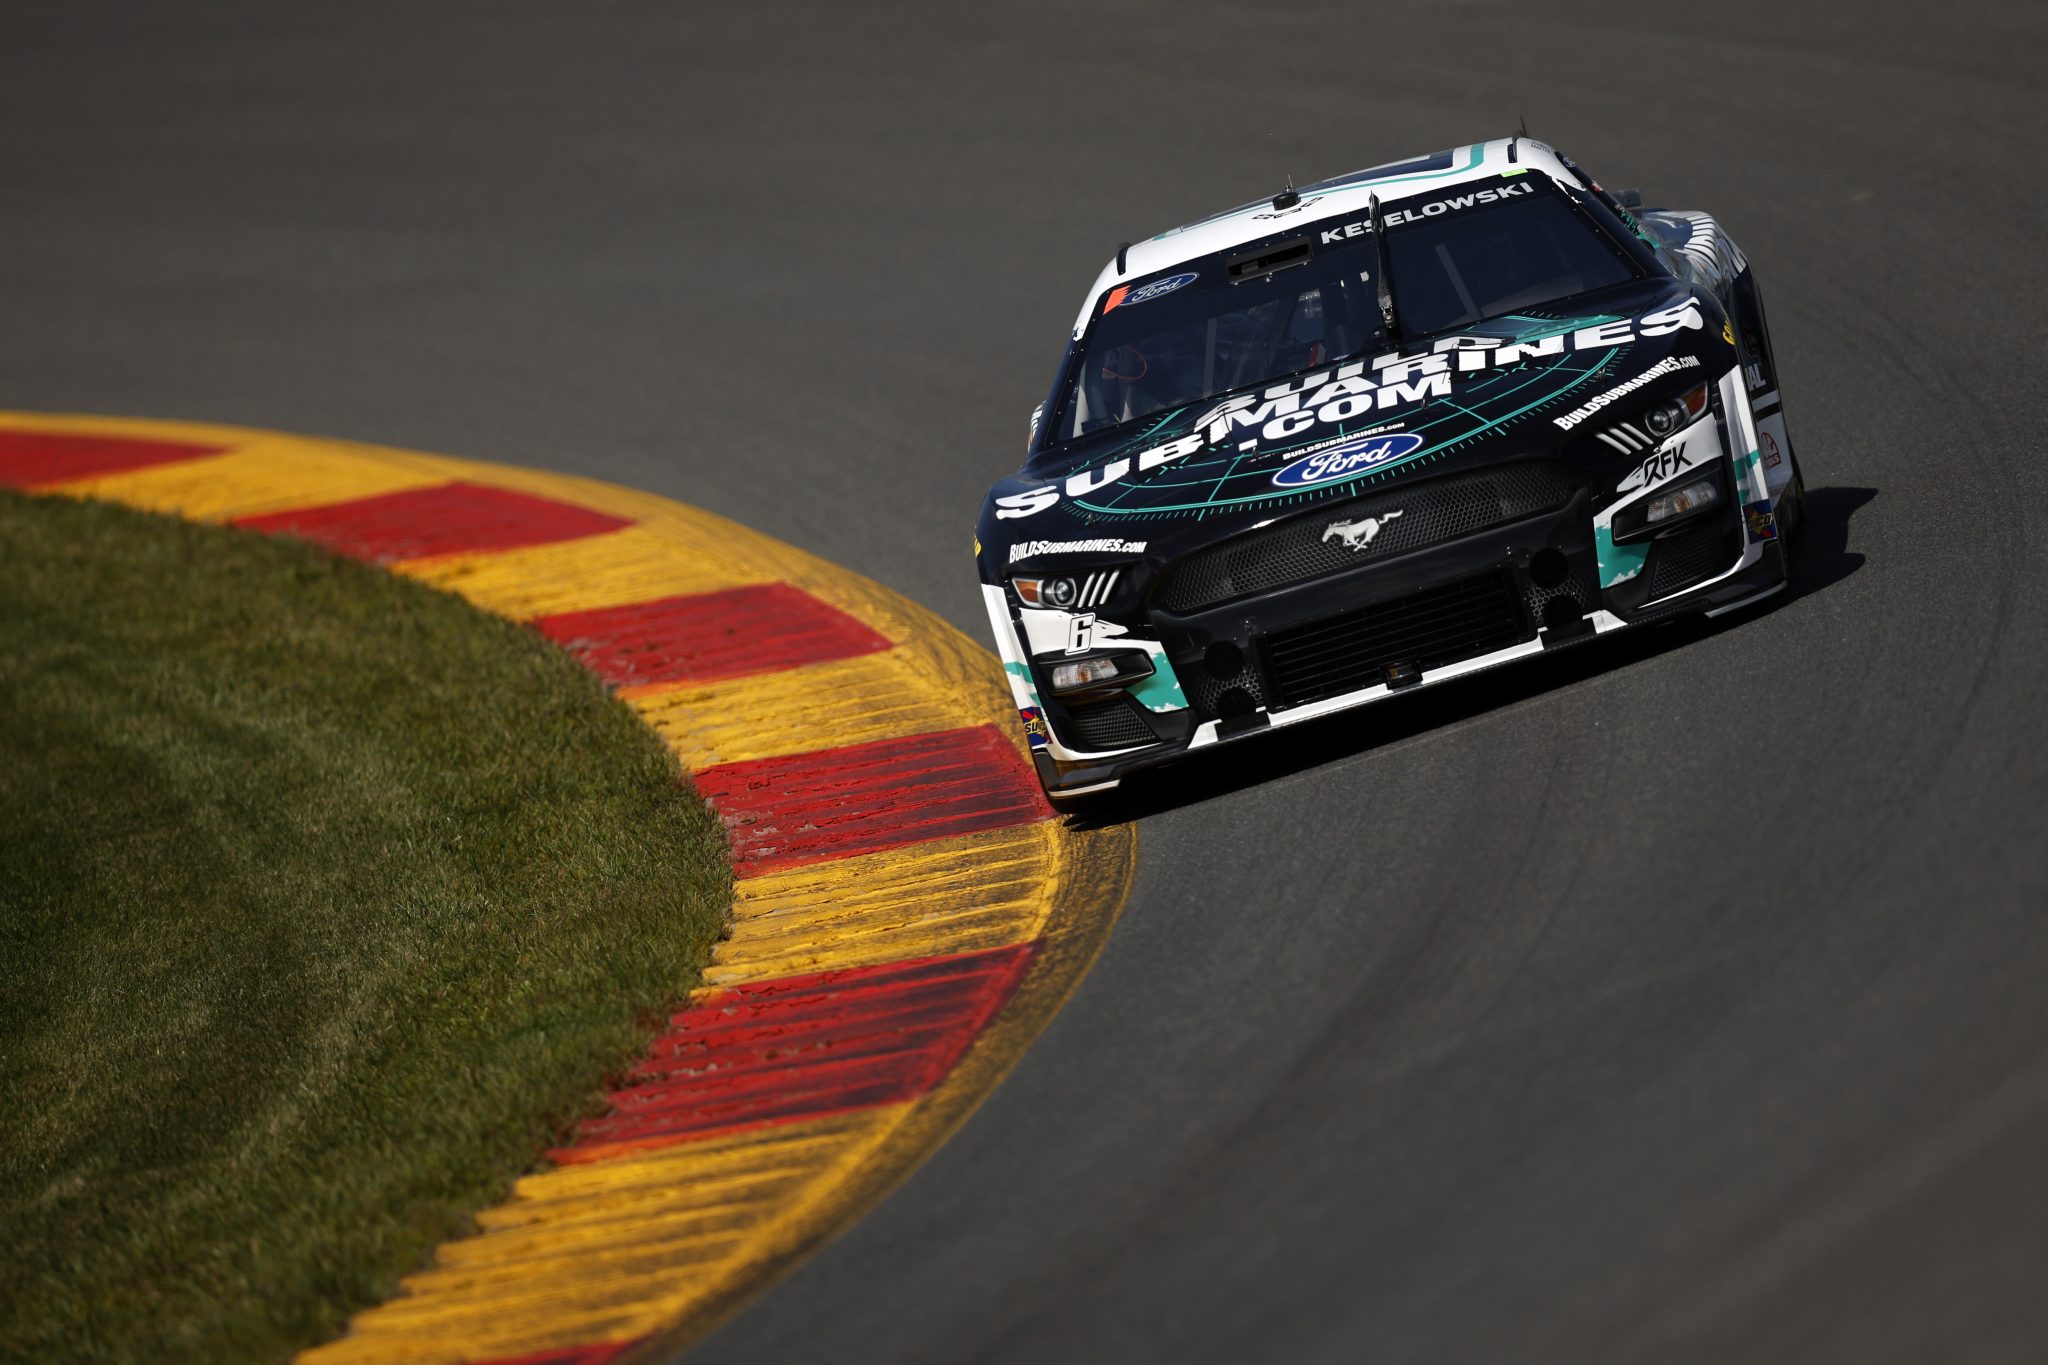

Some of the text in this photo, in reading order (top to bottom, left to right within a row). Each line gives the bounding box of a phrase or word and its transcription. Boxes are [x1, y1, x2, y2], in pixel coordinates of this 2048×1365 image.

[1321, 182, 1535, 244] KESELOWSKI
[996, 297, 1703, 519] SUBMARINES
[1239, 372, 1452, 451] .COM
[1553, 355, 1701, 431] BUILDSUBMARINES.COM
[1643, 441, 1693, 488] RFK
[1009, 539, 1147, 563] BUILDSUBMARINES.COM
[1066, 613, 1095, 655] 6
